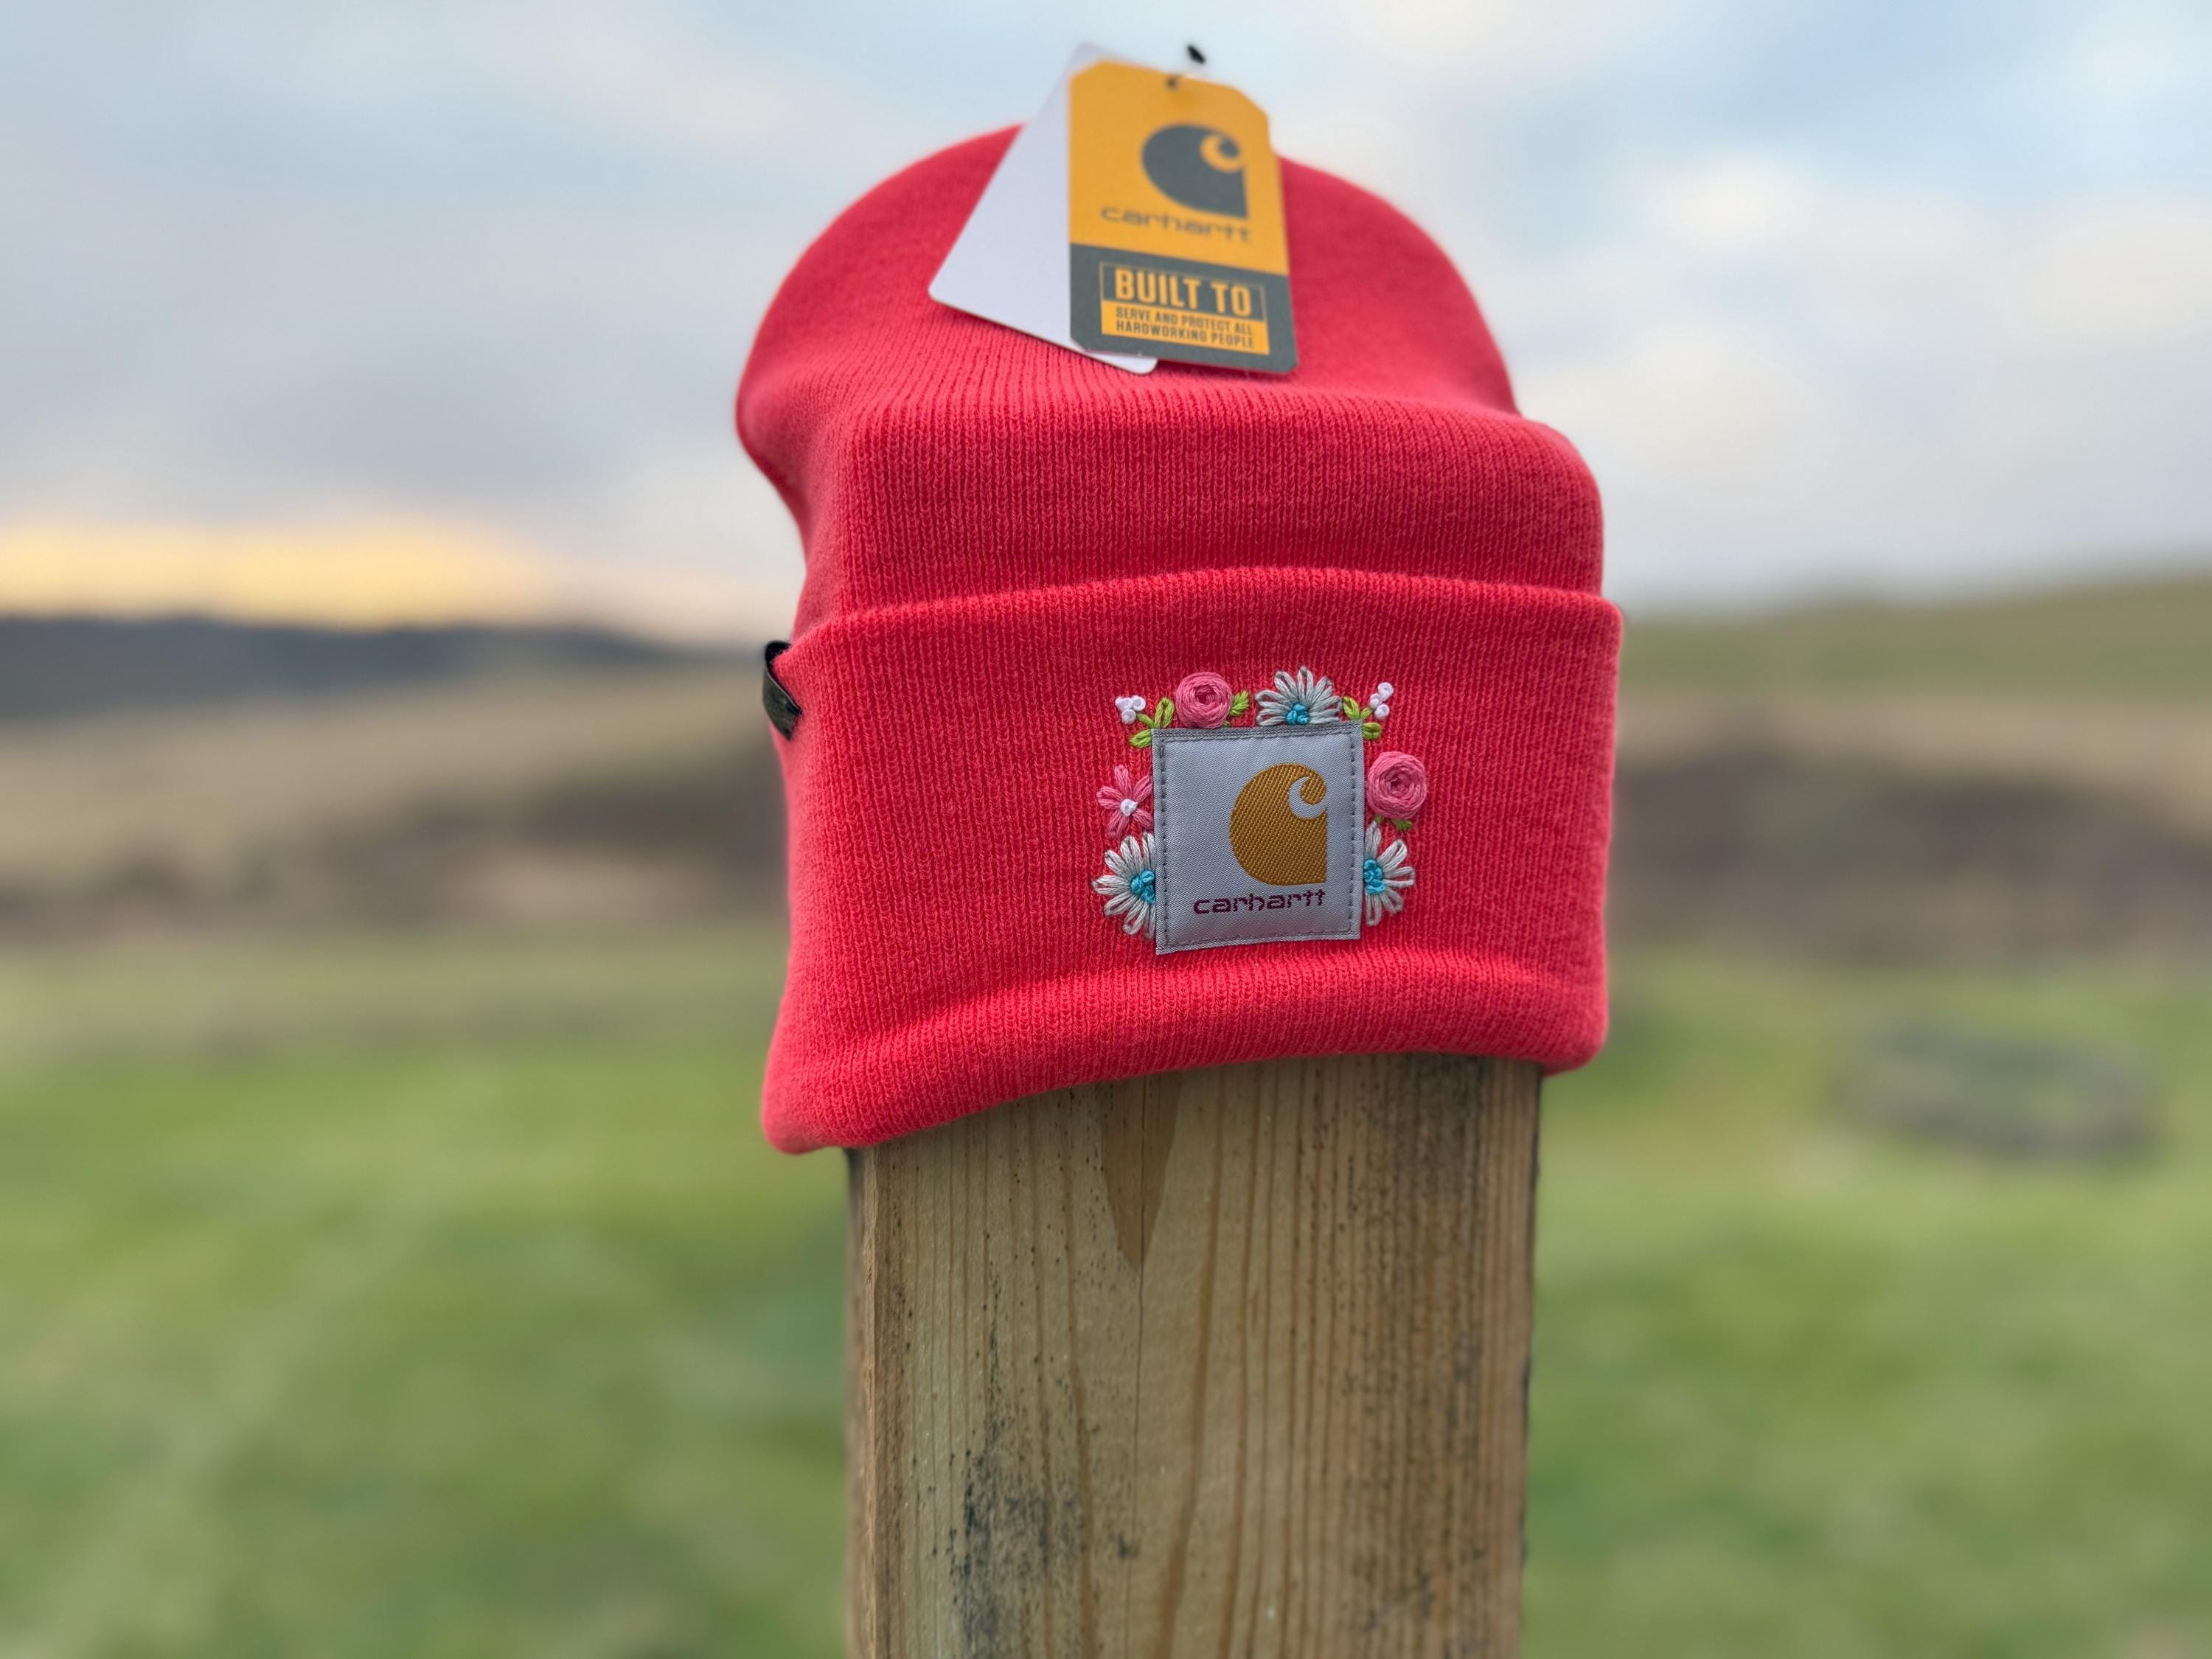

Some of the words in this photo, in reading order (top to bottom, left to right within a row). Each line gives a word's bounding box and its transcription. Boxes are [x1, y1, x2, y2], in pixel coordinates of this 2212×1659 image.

[1100, 206, 1250, 242] carhartt
[1115, 268, 1200, 310] BUILT
[1211, 282, 1252, 318] TO
[1116, 306, 1151, 321] SERVE
[1155, 311, 1178, 326] AND
[1181, 315, 1231, 332] PROTECT
[1234, 322, 1252, 335] ALL
[1116, 319, 1208, 343] HARDWORKING
[1211, 332, 1255, 349] PEOPLE
[1193, 888, 1326, 915] carhartt
